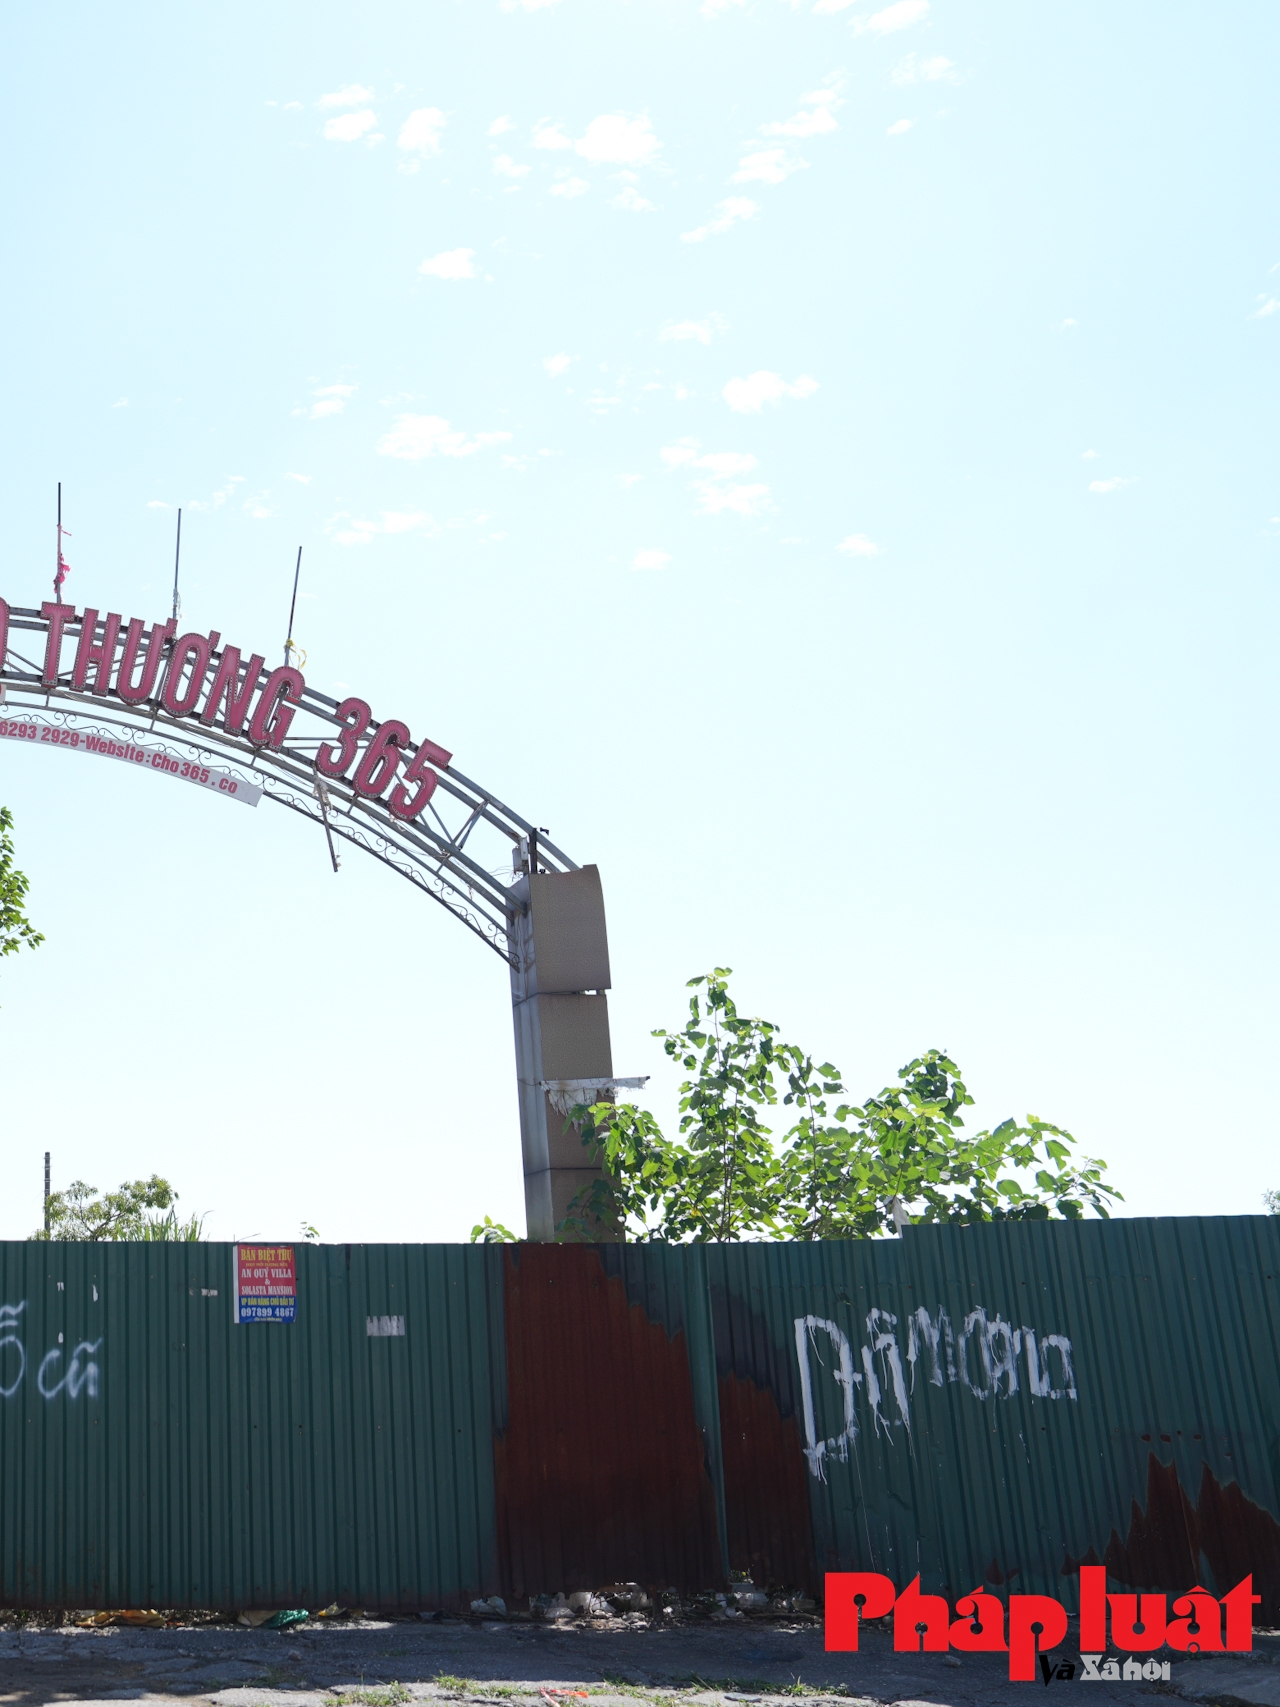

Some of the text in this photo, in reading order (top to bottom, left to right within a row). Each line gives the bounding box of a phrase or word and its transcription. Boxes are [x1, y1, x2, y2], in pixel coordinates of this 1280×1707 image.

[41, 601, 306, 752] THƯƠNG
[316, 697, 454, 822] 365
[0, 719, 37, 740] 6293
[241, 1247, 256, 1261] BÁN
[258, 1247, 275, 1262] BIỆT
[241, 1266, 292, 1278] AN QUÝ VILLA
[241, 1285, 292, 1295] SOLASTA MANSION
[241, 1307, 272, 1317] 097899
